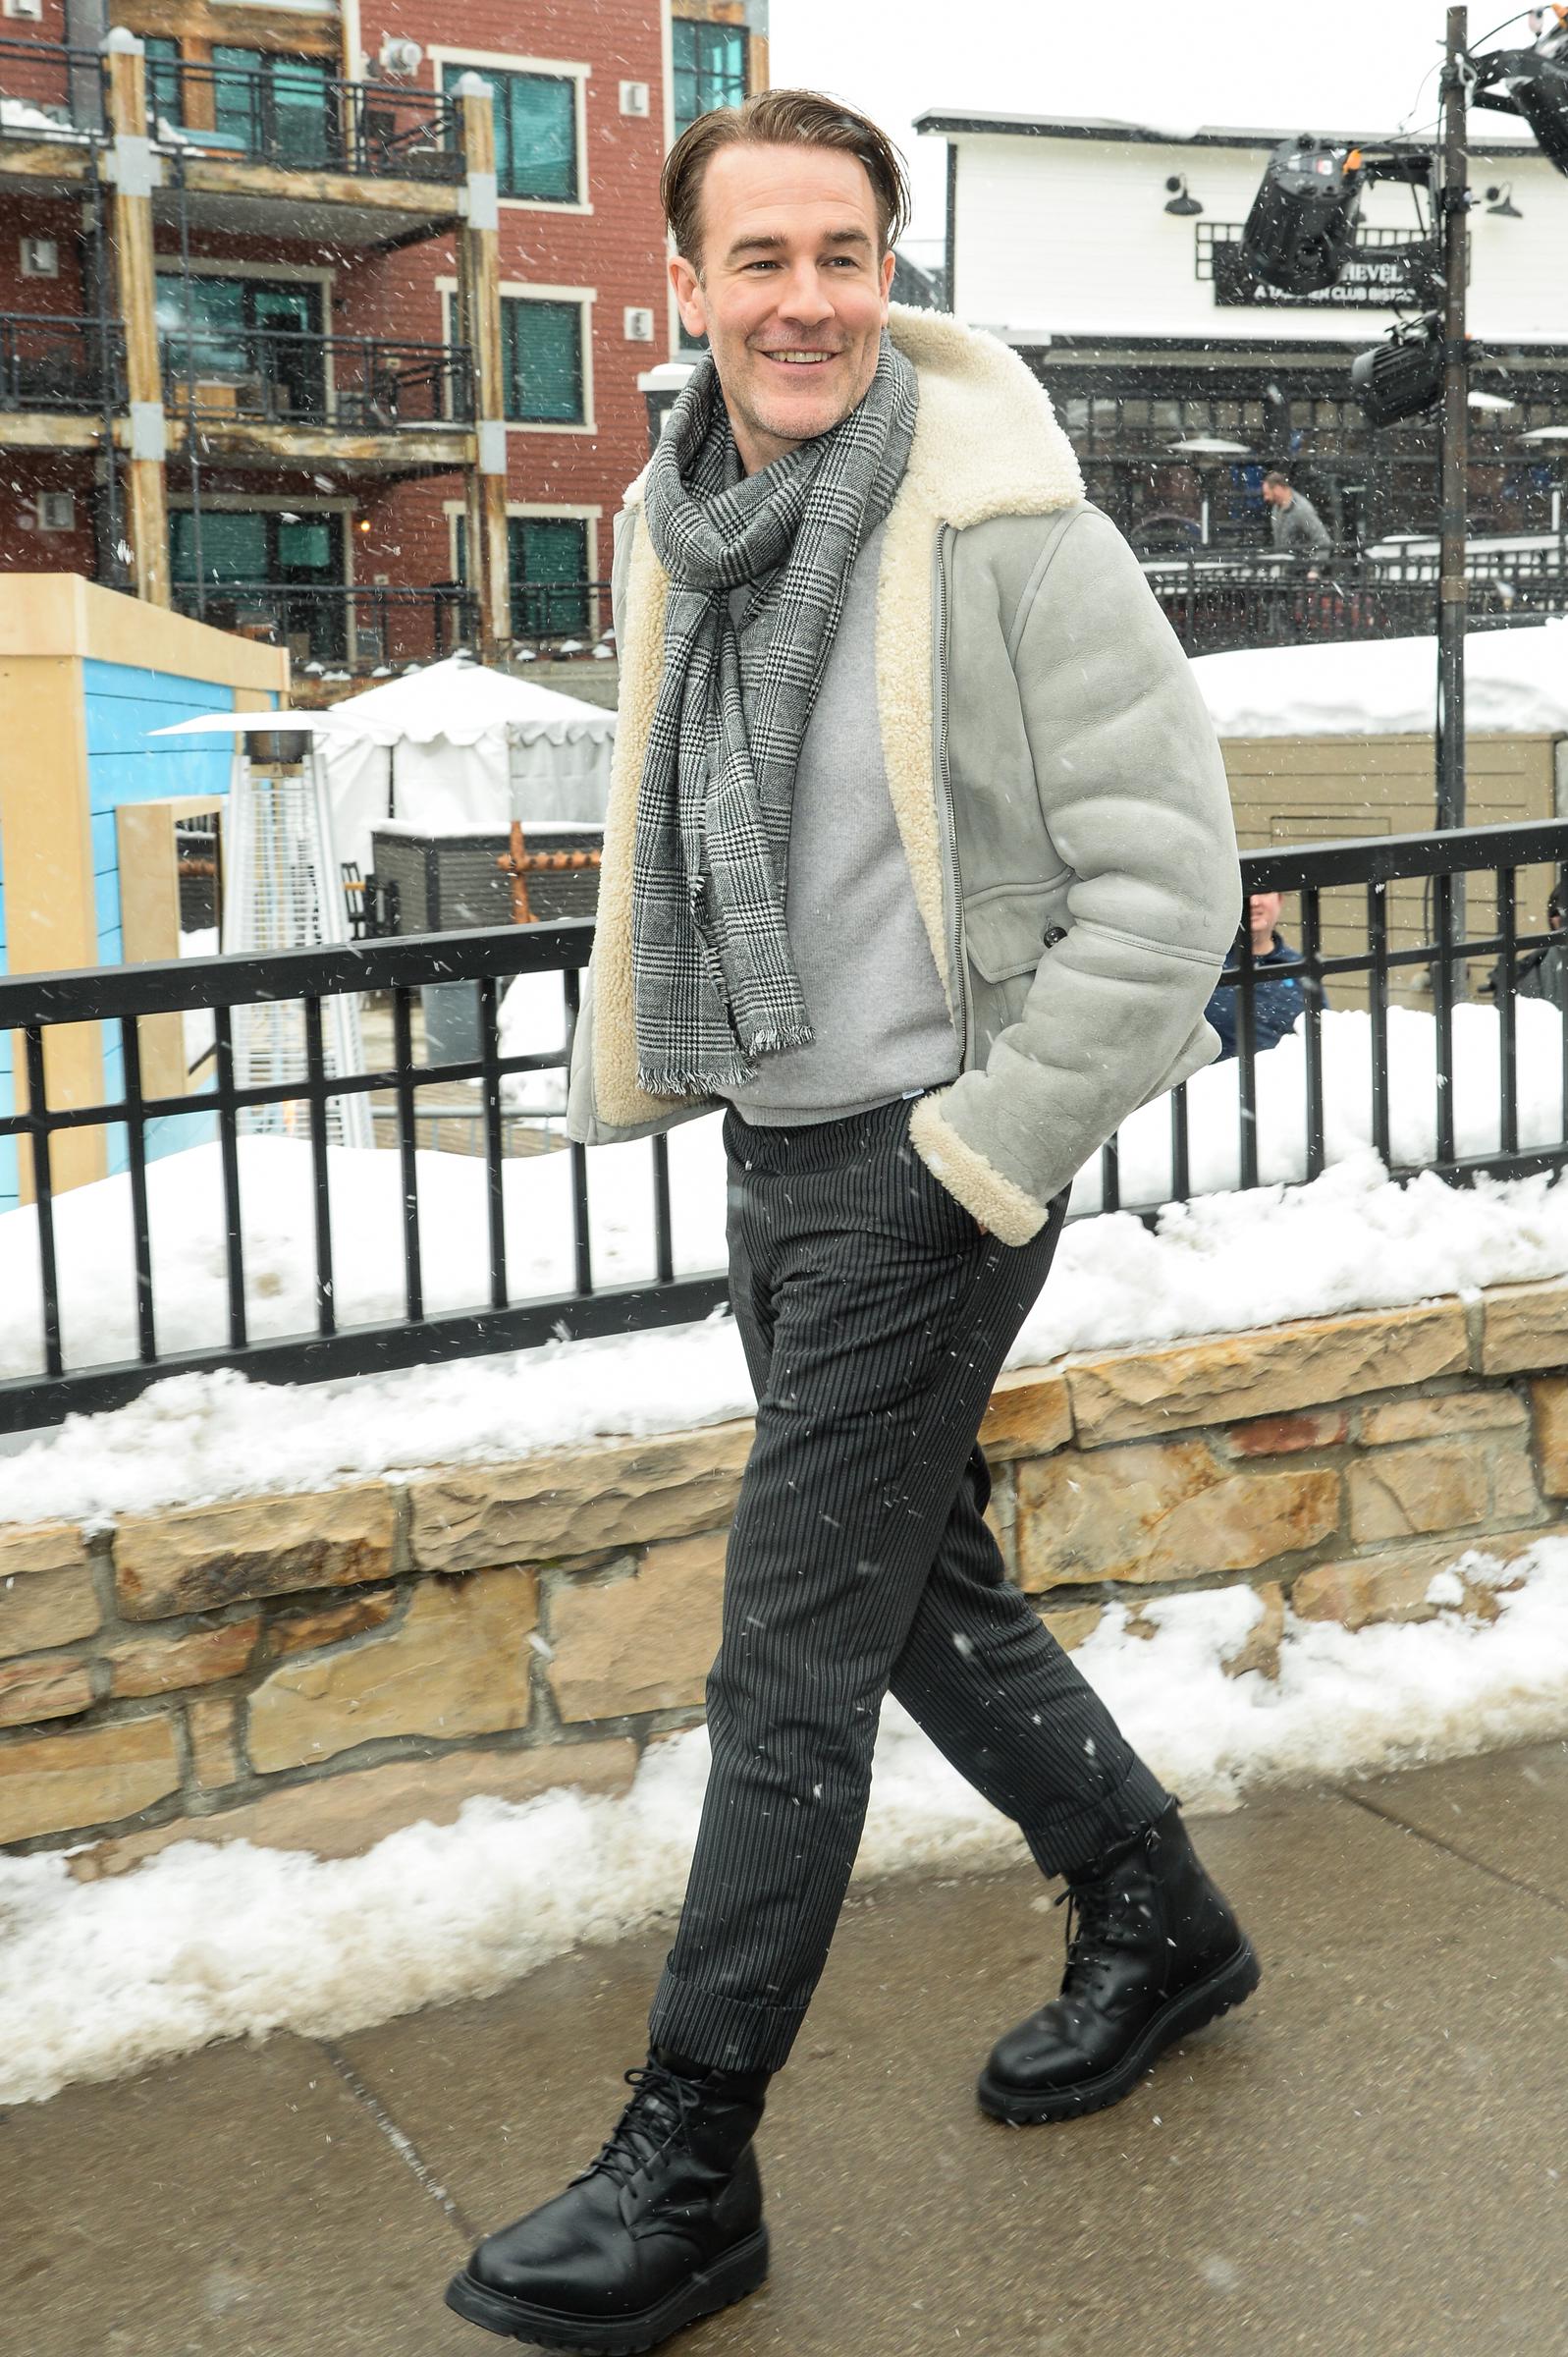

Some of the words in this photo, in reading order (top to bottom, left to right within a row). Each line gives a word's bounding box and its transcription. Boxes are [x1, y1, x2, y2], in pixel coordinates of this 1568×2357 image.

[1341, 262, 1403, 282] HEVEL
[1254, 285, 1267, 300] A
[1330, 286, 1367, 301] CLUB
